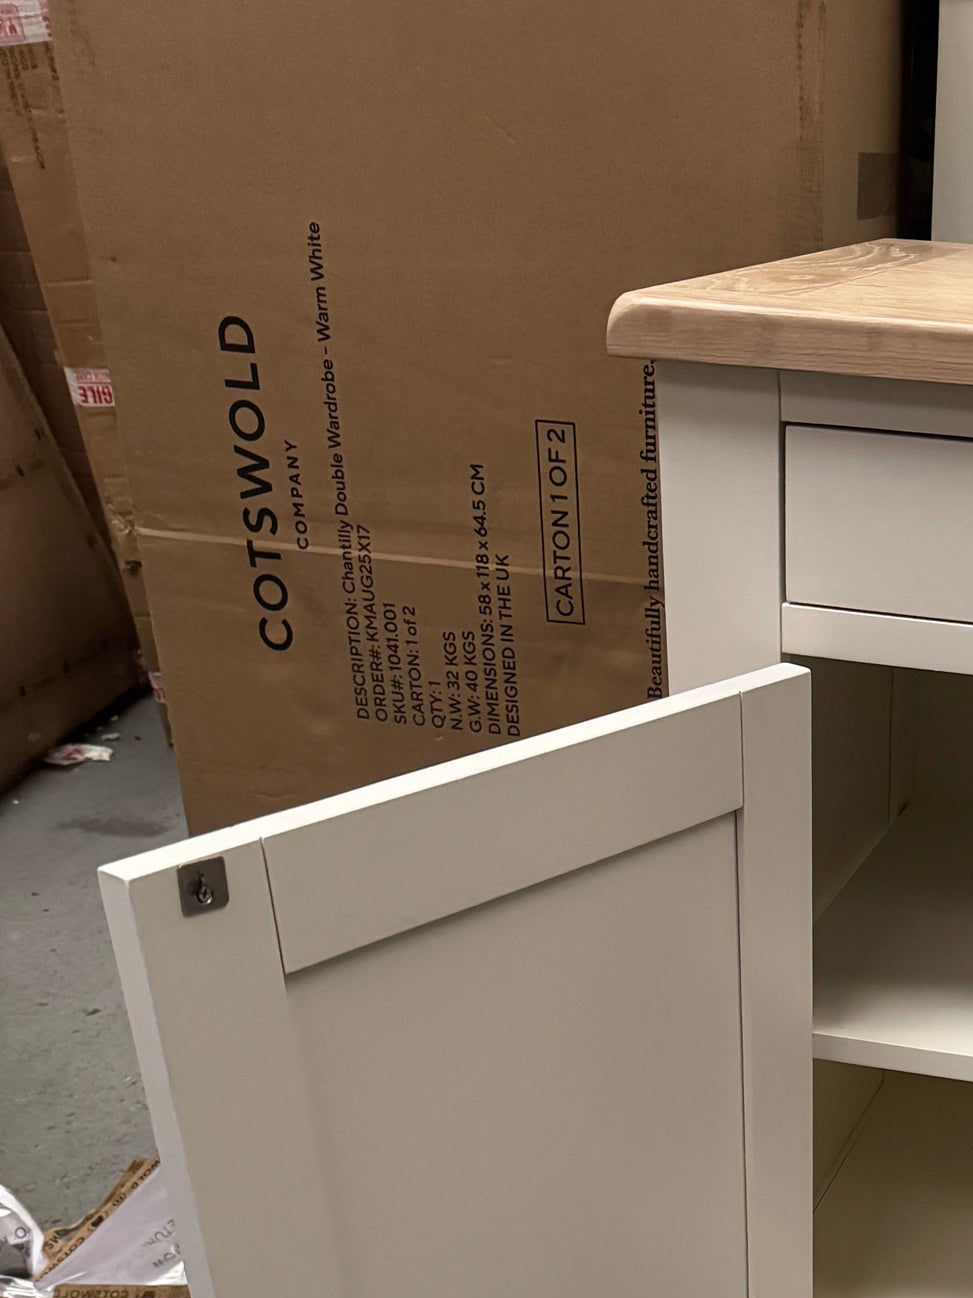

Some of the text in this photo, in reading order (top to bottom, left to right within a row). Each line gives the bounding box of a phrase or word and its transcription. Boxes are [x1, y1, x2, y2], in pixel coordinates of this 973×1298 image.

[307, 222, 324, 281] White
[315, 287, 331, 342] Warm
[78, 385, 113, 404] GILE
[322, 359, 341, 449] Wardrobe
[218, 316, 293, 651] COTSWOLD
[284, 440, 309, 549] COMPANY
[330, 453, 348, 516] Double
[547, 429, 574, 617] CARTON 1 OF 2
[638, 359, 665, 699] Beautifully handcrafted furniture.
[338, 519, 355, 594] Chantilly
[470, 464, 501, 734] DIMENSIONS: 58 x 118 x 64.5 CM
[356, 524, 388, 722] ORDER#: KMAUG25X17
[402, 606, 415, 616] 2
[403, 618, 417, 636] of
[495, 554, 520, 736] DESIGNED IN THE UK
[344, 598, 370, 719] DESCRIPTION:
[383, 603, 407, 725] SKU#: 1041.001
[406, 650, 426, 726] CARTON:
[442, 632, 463, 730] N.W: 32 KGS
[462, 631, 482, 733] G.W: 40 KGS
[429, 691, 446, 728] QTY:
[131, 1159, 161, 1189] WOLD
